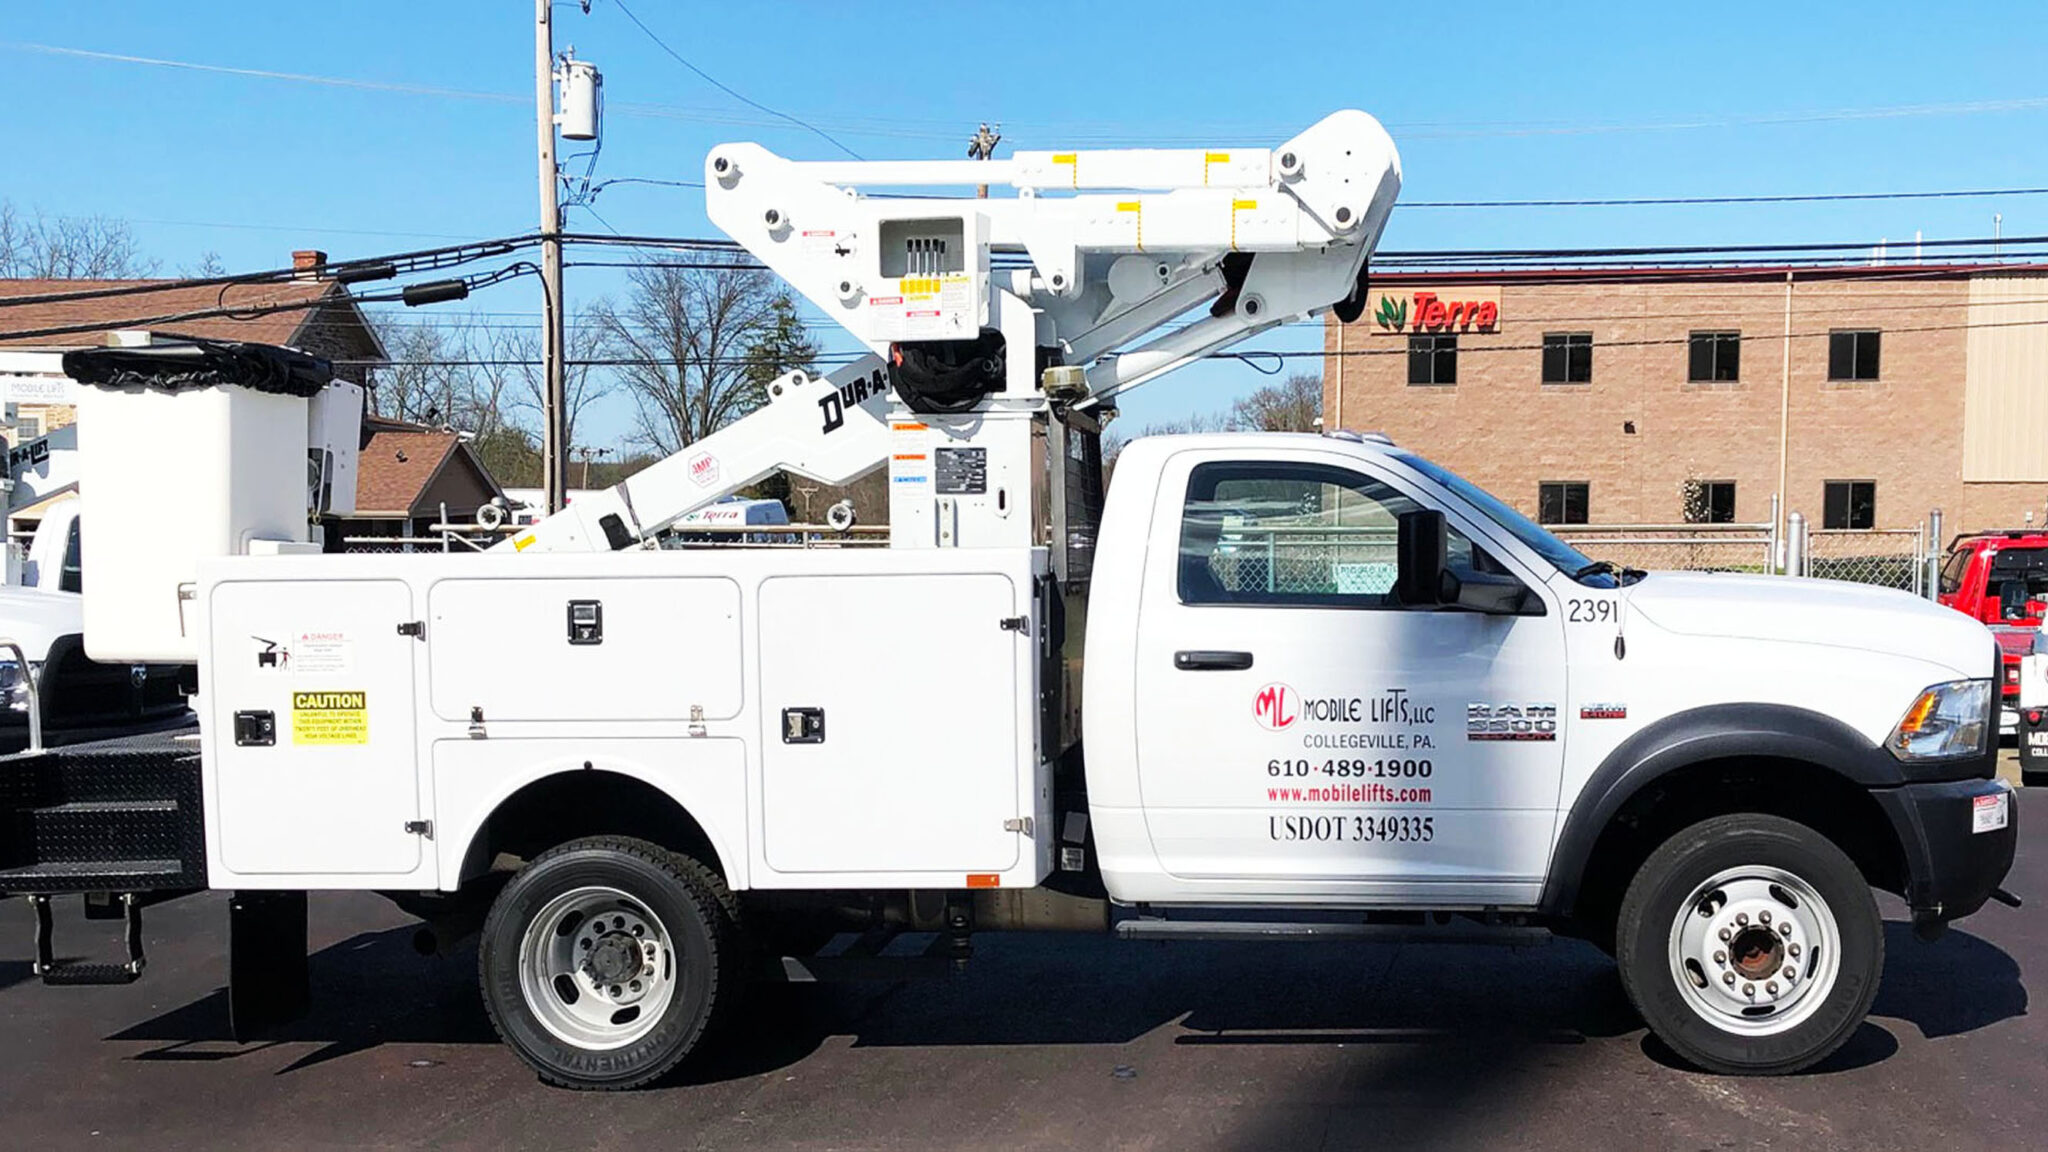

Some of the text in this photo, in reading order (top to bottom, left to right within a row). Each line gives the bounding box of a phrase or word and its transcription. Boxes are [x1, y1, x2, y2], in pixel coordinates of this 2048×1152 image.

[1412, 292, 1498, 331] Terra
[702, 509, 739, 519] Terra
[1568, 599, 1618, 622] 2391
[295, 694, 363, 708] CAUTION
[1256, 687, 1295, 727] ML
[1303, 698, 1362, 722] MOBILE
[1467, 702, 1557, 718] RAM
[1303, 734, 1436, 750] COLLEGEVILLE, PA.
[1267, 783, 1432, 802] www.mobilelifts.com
[1269, 816, 1434, 841] USDOT 3349335
[553, 1021, 678, 1072] CONTINENTAL
